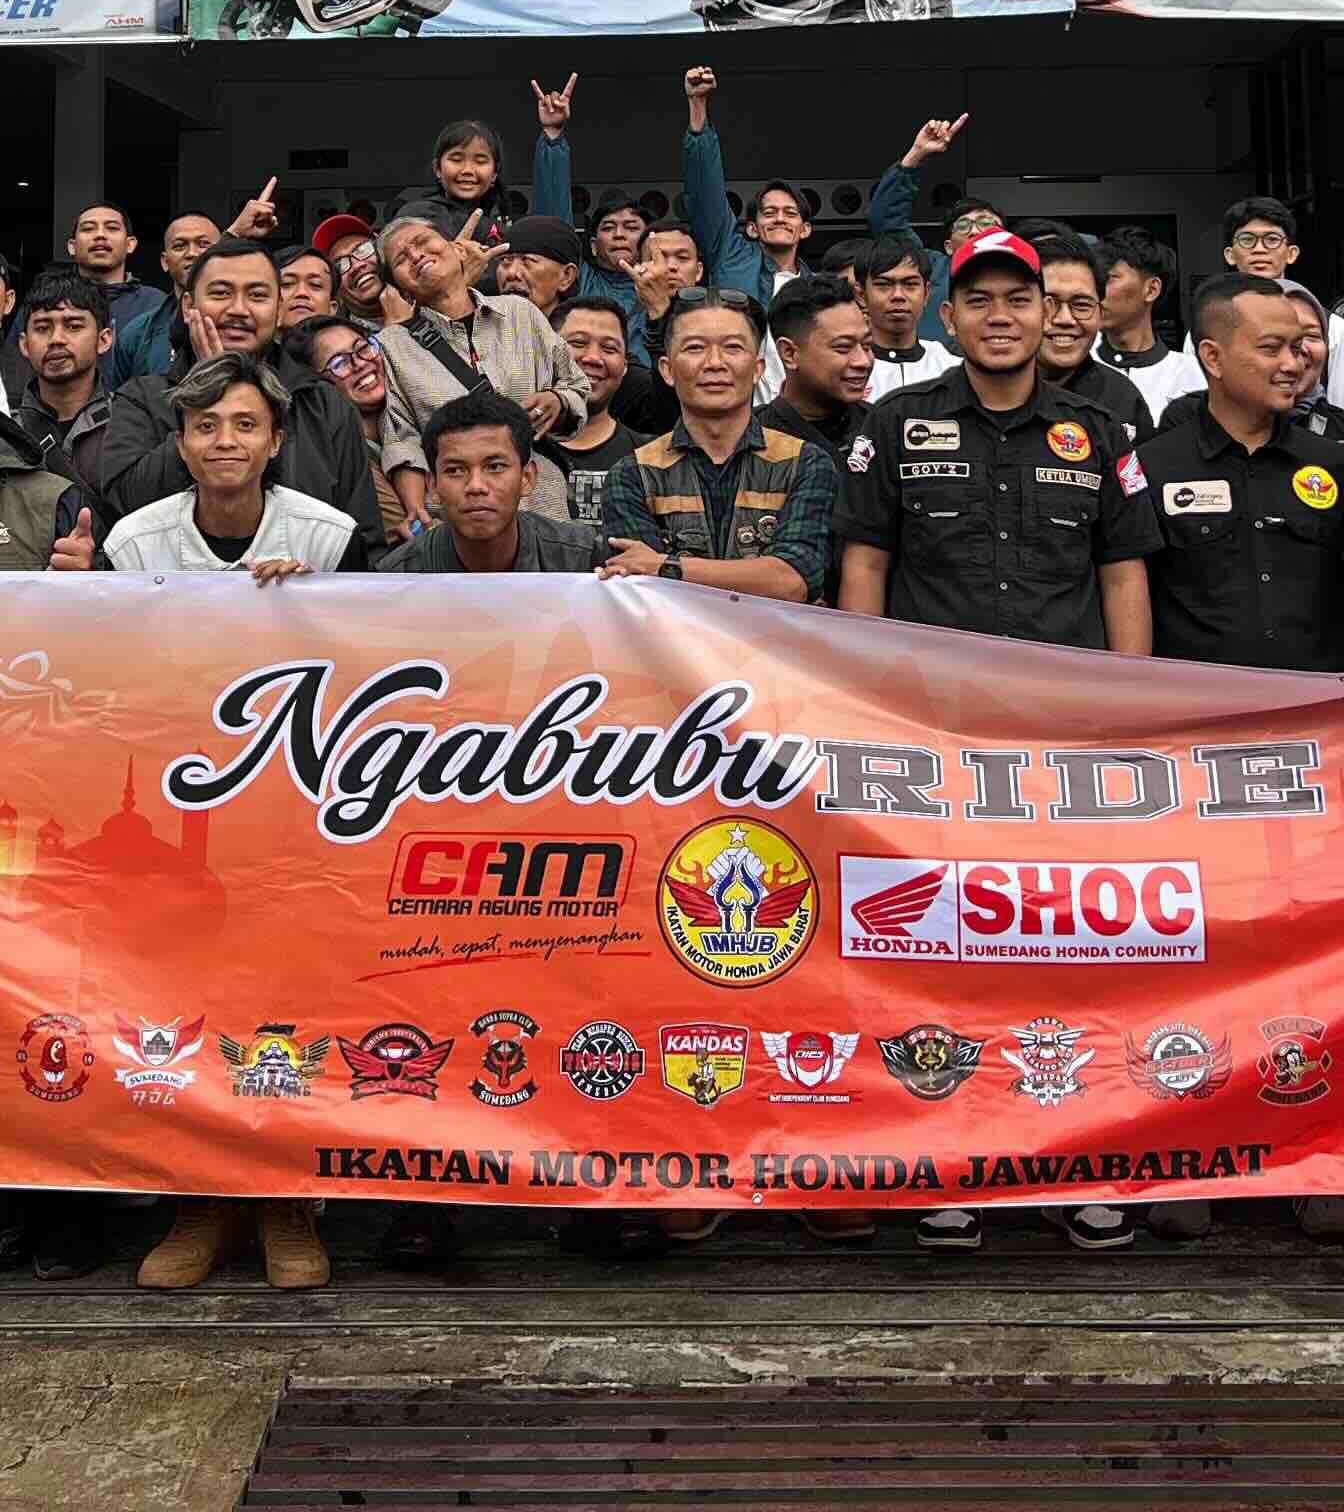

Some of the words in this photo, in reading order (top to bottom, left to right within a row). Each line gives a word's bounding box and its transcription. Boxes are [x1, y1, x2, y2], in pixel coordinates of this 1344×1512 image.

[1039, 470, 1072, 481] KETUA
[162, 659, 819, 843] Ngabubu
[814, 739, 1326, 823] RIDE
[388, 899, 471, 917] CEMARA
[479, 899, 542, 917] AGUNG
[548, 901, 618, 918] MOTOR
[962, 866, 1194, 937] SHOC
[380, 934, 444, 960] mudah,
[452, 932, 501, 961] cepat,
[509, 923, 643, 960] menyenangkan
[666, 905, 689, 951] IKATAN
[686, 943, 723, 977] MOTOR
[724, 962, 767, 978] HONDA
[767, 943, 795, 971] JAWA
[792, 905, 810, 945] BARAT
[703, 932, 777, 953] IMHJB
[850, 936, 954, 955] HONDA
[965, 944, 1051, 958] SUMEDANG
[1056, 944, 1111, 958] HONDA
[1115, 944, 1198, 958] COMUNITY
[666, 1035, 744, 1052] KANDAS
[479, 1089, 529, 1106] SUMEDANG
[314, 1147, 513, 1186] IKATAN
[528, 1151, 735, 1190] MOTOR
[749, 1153, 944, 1191] HONDA
[958, 1144, 1272, 1189] JAWABARAT
